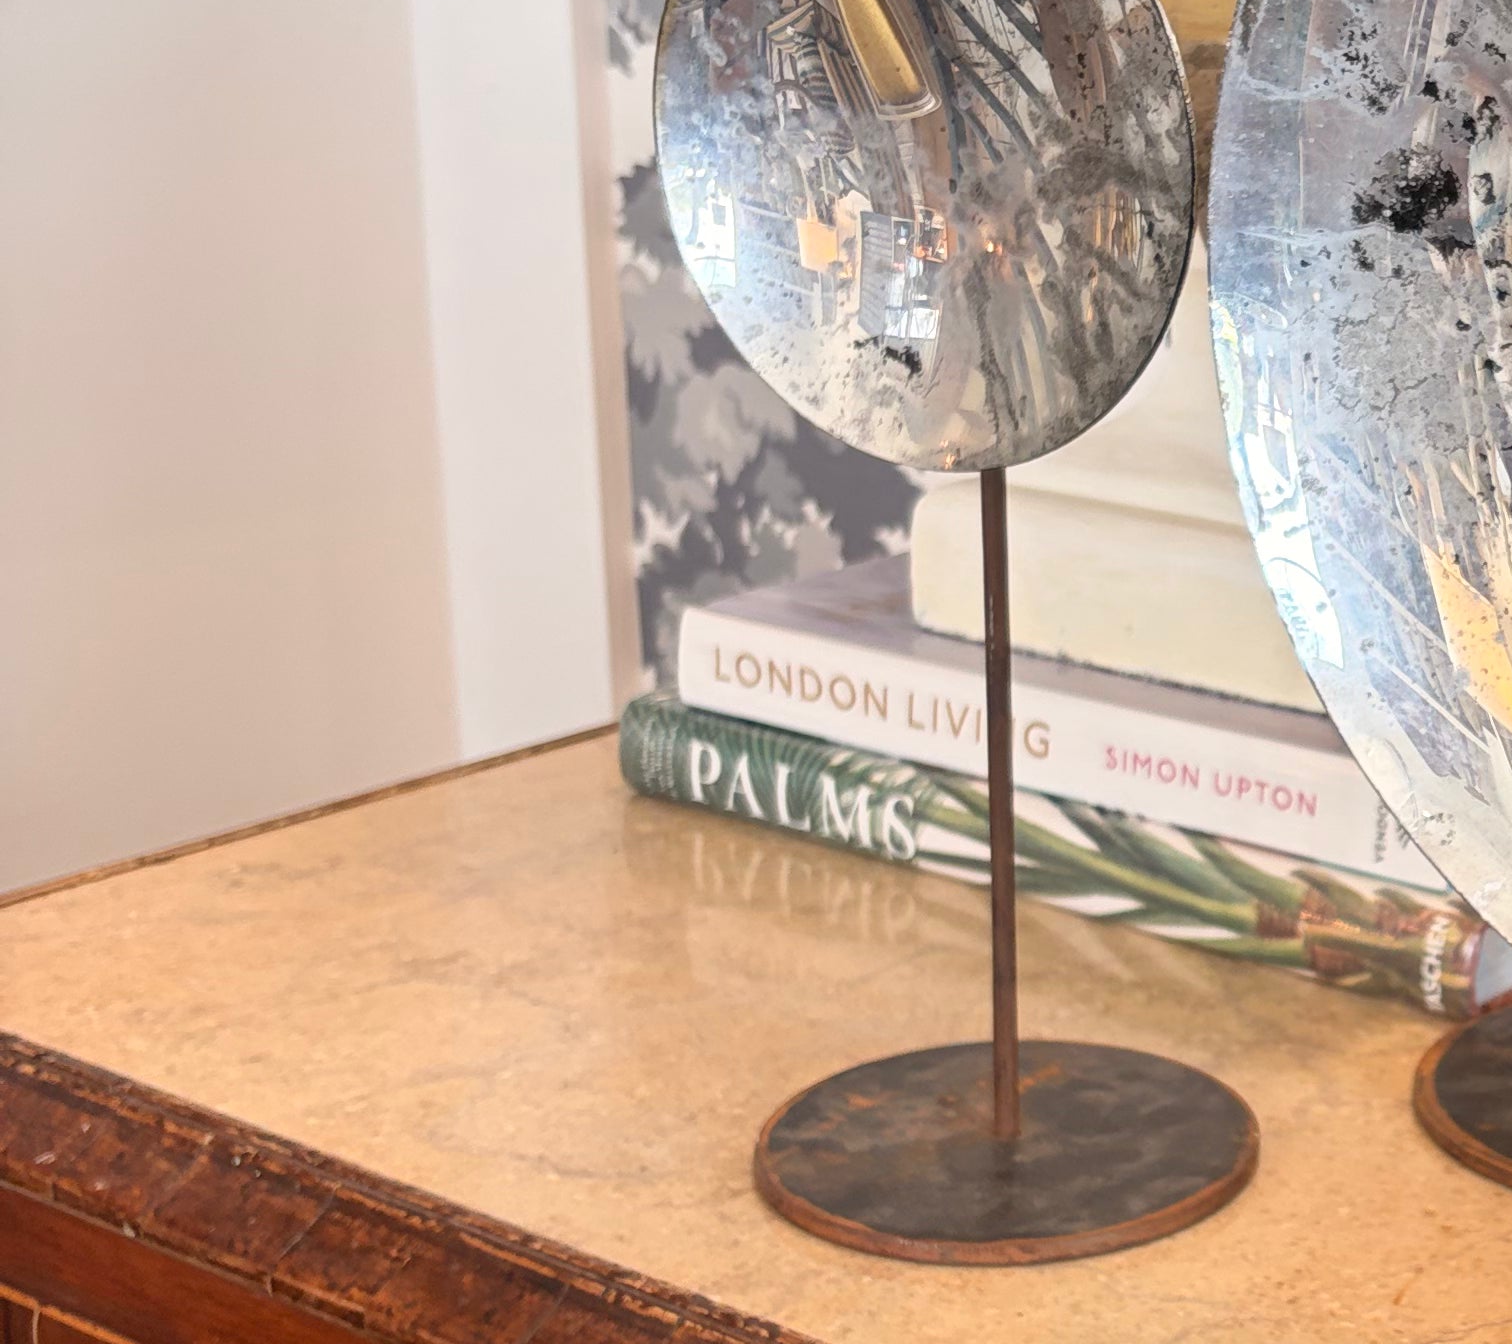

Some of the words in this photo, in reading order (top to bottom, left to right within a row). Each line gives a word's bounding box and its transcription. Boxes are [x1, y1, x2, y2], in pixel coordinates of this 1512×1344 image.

[714, 644, 889, 722] LONDON
[907, 691, 1051, 759] LIVIG
[688, 737, 917, 861] PALMS
[1105, 746, 1200, 790] SIMON
[1213, 771, 1318, 818] UPTON
[1419, 915, 1450, 1012] ASCHEN
